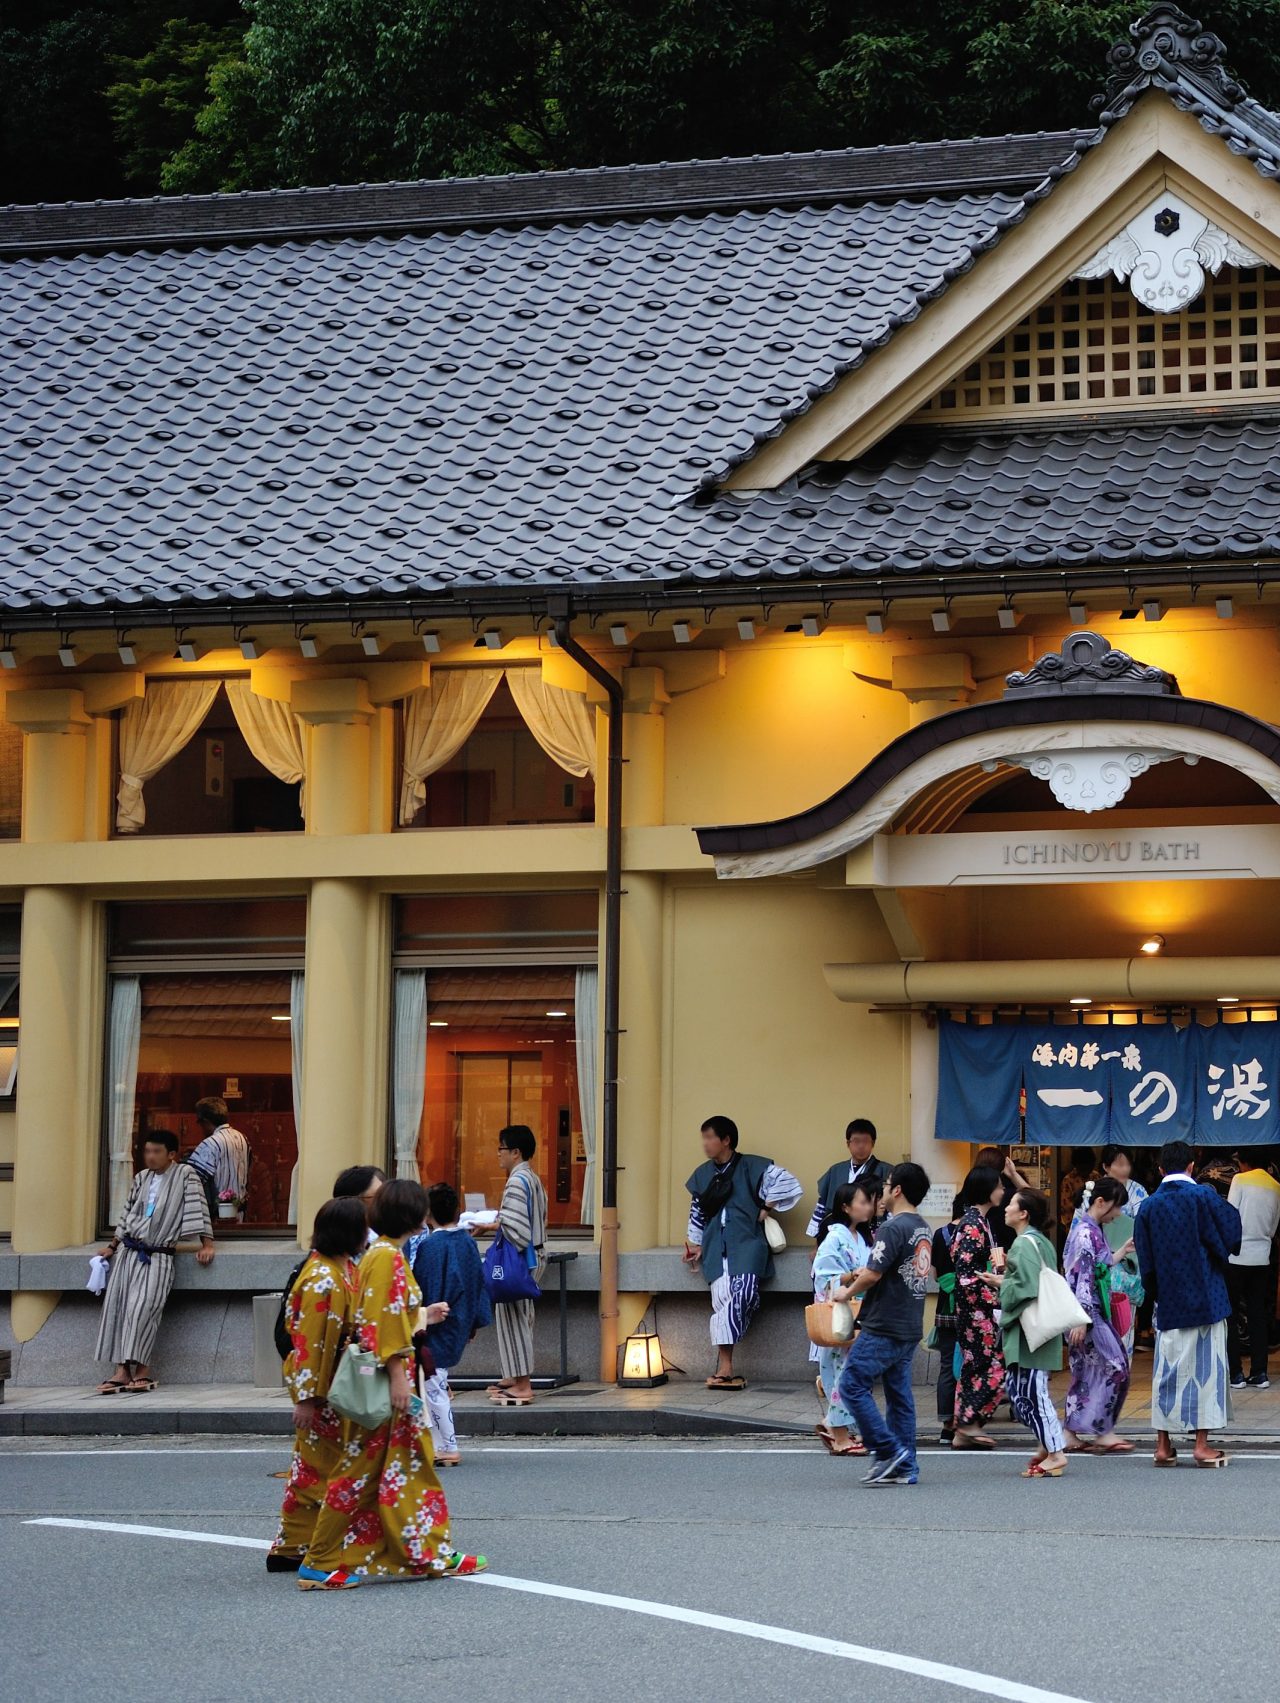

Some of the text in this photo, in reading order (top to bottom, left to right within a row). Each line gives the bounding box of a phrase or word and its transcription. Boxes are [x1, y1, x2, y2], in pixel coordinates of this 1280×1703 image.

[1004, 841, 1200, 865] ICHINOYU BATH
[1032, 1042, 1142, 1072] 海内第一泉
[1037, 1058, 1271, 1125] 一の湯
